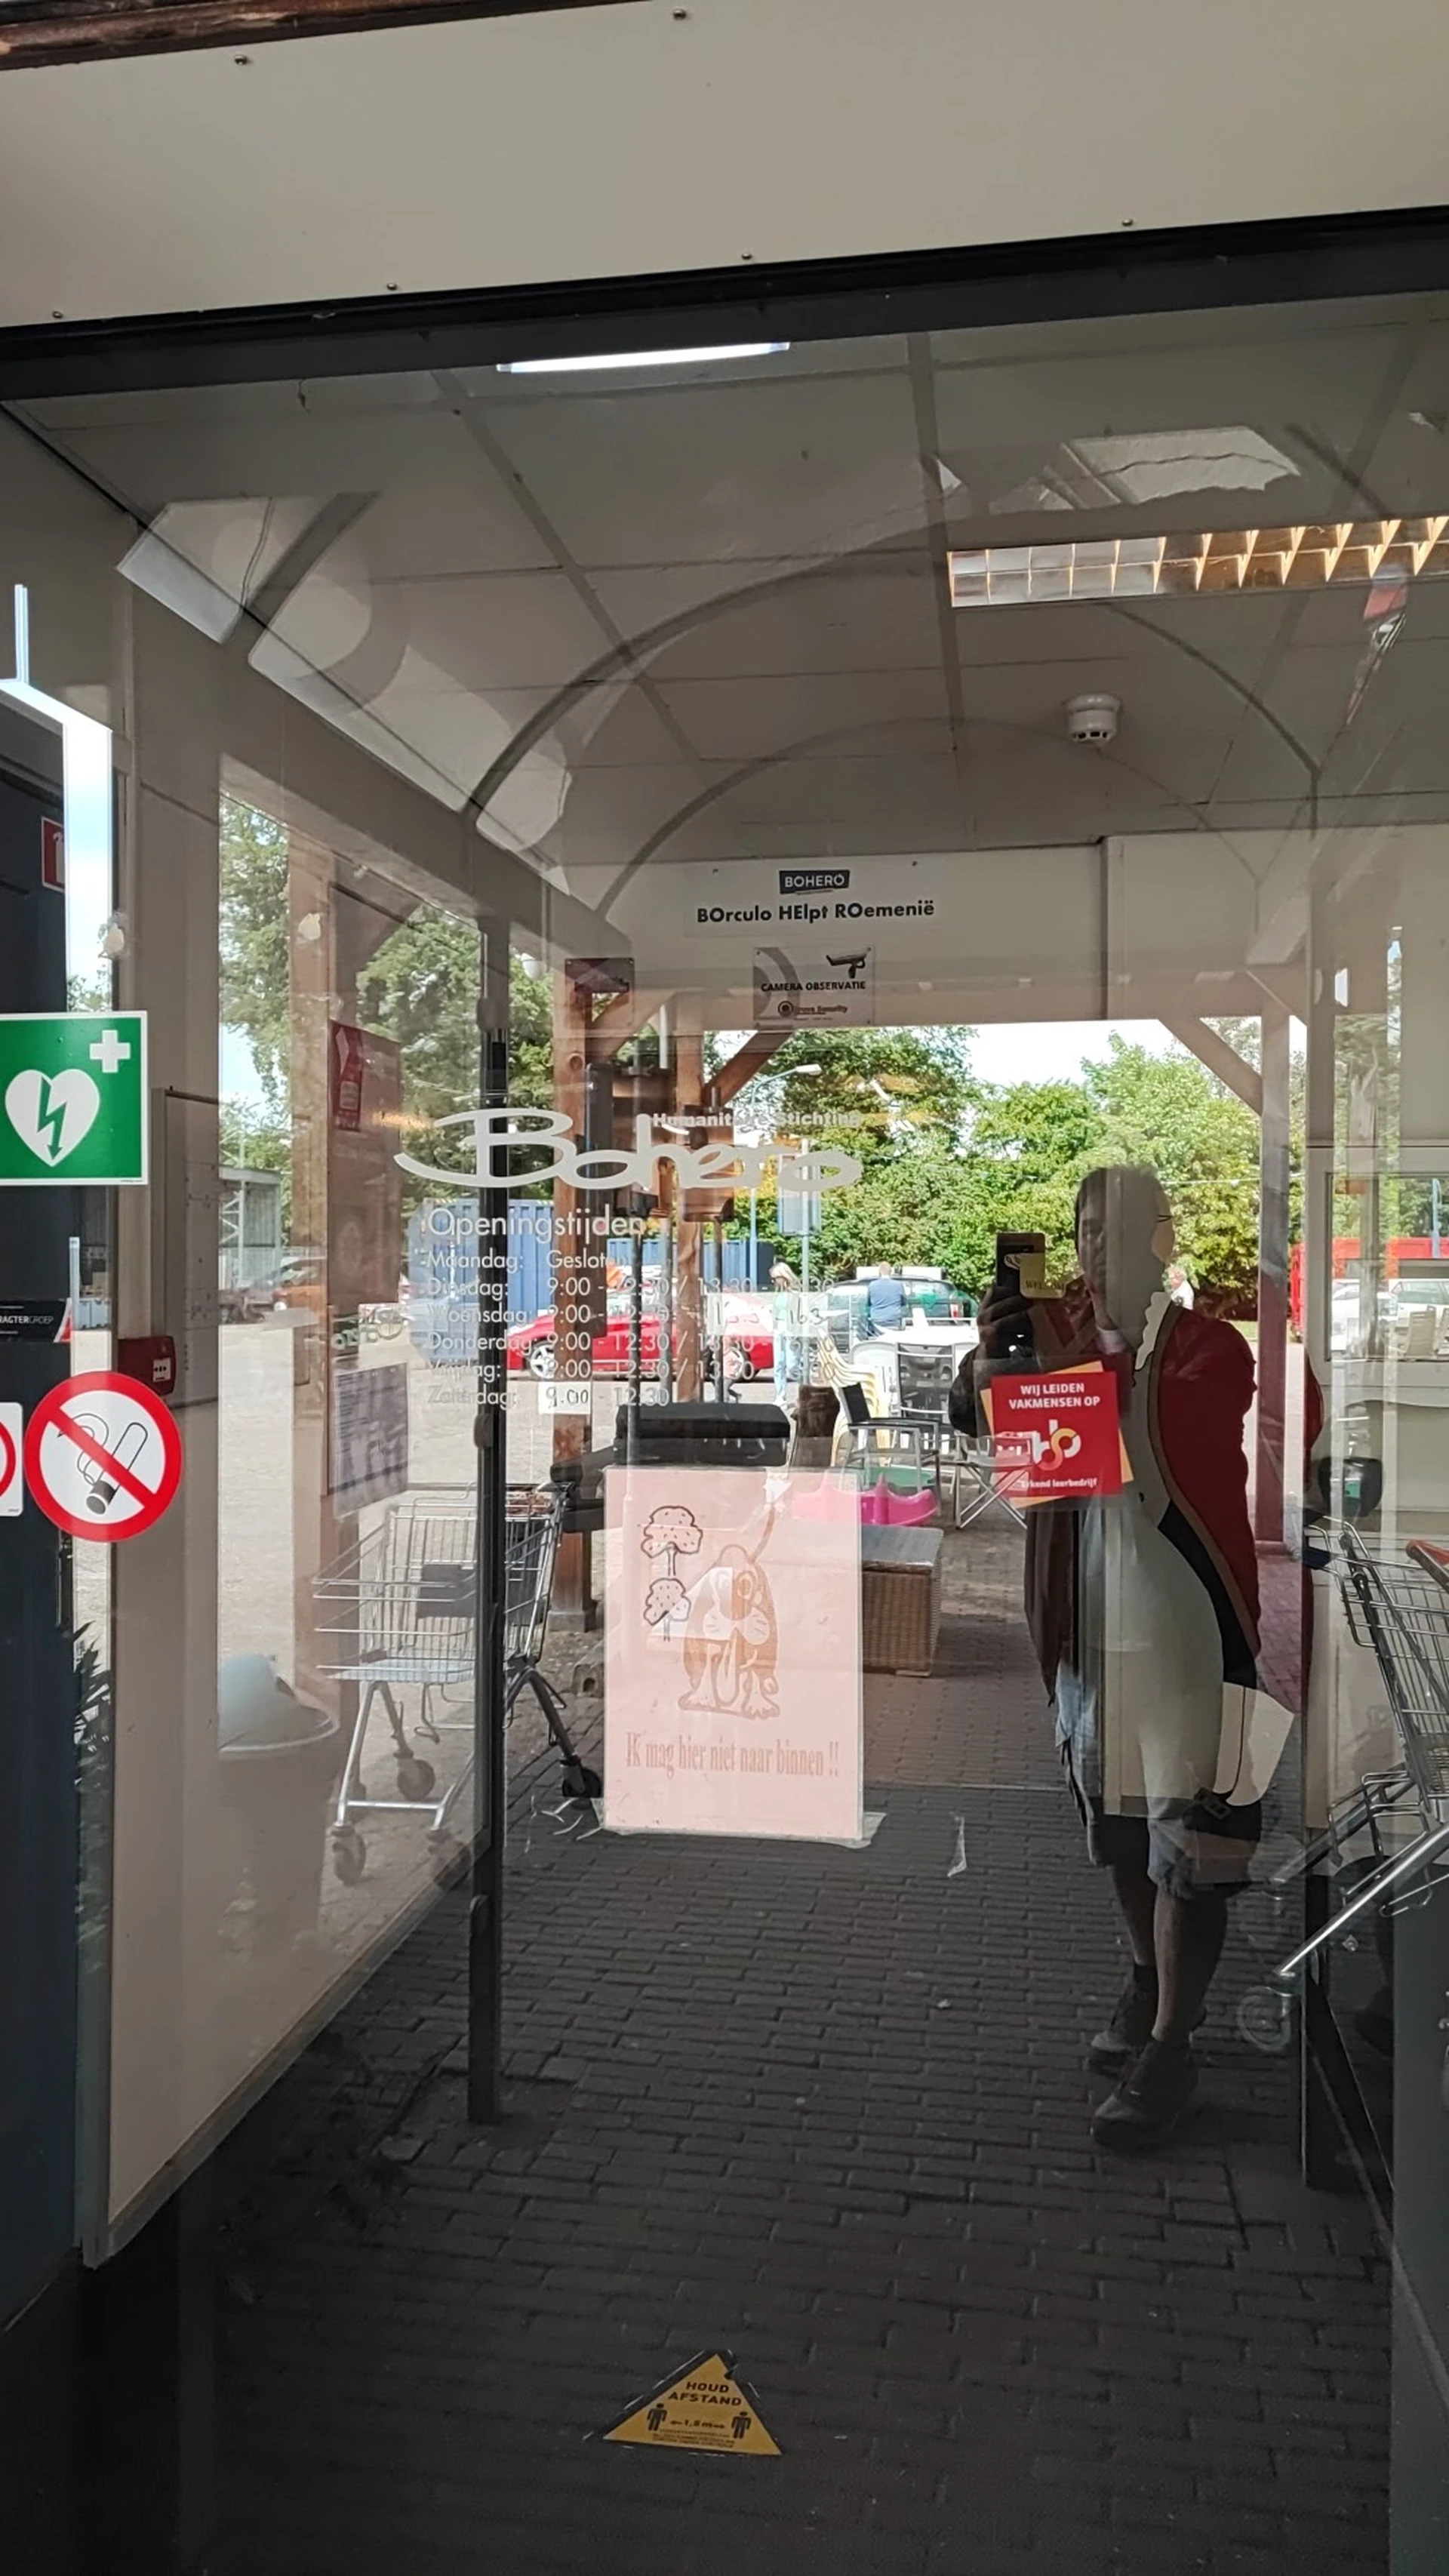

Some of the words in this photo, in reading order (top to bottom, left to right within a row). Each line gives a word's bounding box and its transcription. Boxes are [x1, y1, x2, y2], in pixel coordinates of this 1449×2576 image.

[784, 873, 845, 888] BOHERO
[697, 905, 772, 923] BOrculo
[778, 903, 829, 924] HElpt
[835, 900, 935, 919] ROemenië
[760, 982, 803, 992] CAMERA
[805, 981, 866, 991] OBSERVATIE
[654, 1112, 769, 1127] Humanitre
[393, 1107, 862, 1191] Bohero
[427, 1204, 645, 1244] Openingstijden
[426, 1248, 524, 1273] Maandag:
[546, 1277, 591, 1296] 9:00
[614, 1277, 669, 1296] 2:30
[697, 1277, 754, 1295] 1330
[427, 1303, 534, 1327] Woensdag:
[546, 1304, 591, 1324] 9:00
[614, 1304, 669, 1324] 2:0
[427, 1329, 537, 1355] Donderdag:
[546, 1332, 591, 1350] 9:00
[614, 1332, 670, 1351] 12:30
[697, 1333, 755, 1352] 1330
[546, 1359, 591, 1378] 9:00
[614, 1359, 670, 1379] 12:30
[697, 1360, 755, 1380] 130
[612, 1386, 670, 1407] 12:30
[1020, 1385, 1041, 1396] WIJ
[1043, 1383, 1084, 1395] LEIDEN
[1008, 1397, 1081, 1410] VAKMENSEN
[1084, 1396, 1100, 1407] OP
[645, 1742, 675, 1780] mag
[678, 1733, 706, 1771] hier
[709, 1735, 737, 1772] niet
[740, 1745, 774, 1773] naar
[776, 1738, 824, 1776] binnen
[685, 2381, 729, 2393] HOUD
[668, 2391, 742, 2406] AFSTAND
